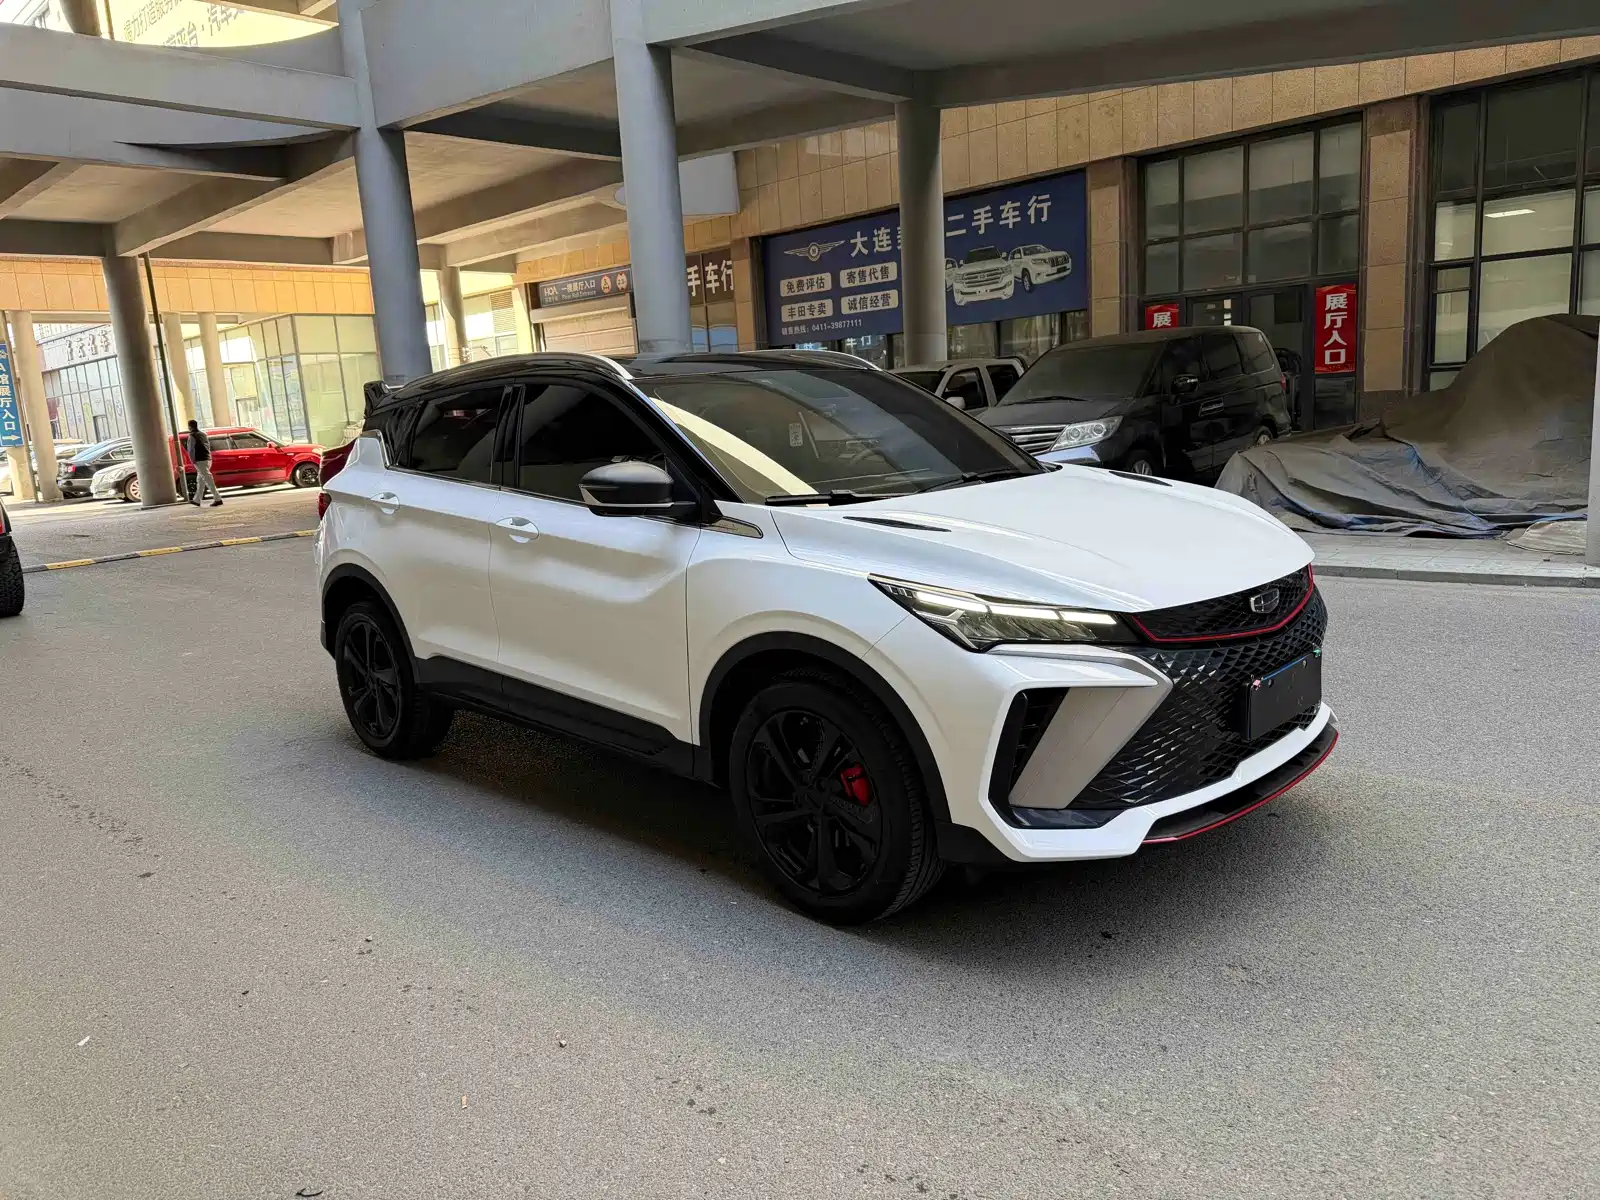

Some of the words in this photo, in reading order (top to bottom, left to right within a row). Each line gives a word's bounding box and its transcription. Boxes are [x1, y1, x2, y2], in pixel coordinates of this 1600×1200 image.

[849, 226, 901, 258] 大连
[945, 194, 1052, 237] 二手车行
[686, 259, 734, 297] 手车行
[846, 264, 890, 285] 寄售代售
[786, 277, 825, 294] 免费评估
[787, 302, 827, 319] 丰田专卖
[847, 293, 891, 312] 诚信经营
[1153, 311, 1172, 328] 展
[1323, 292, 1348, 365] 展厅入口
